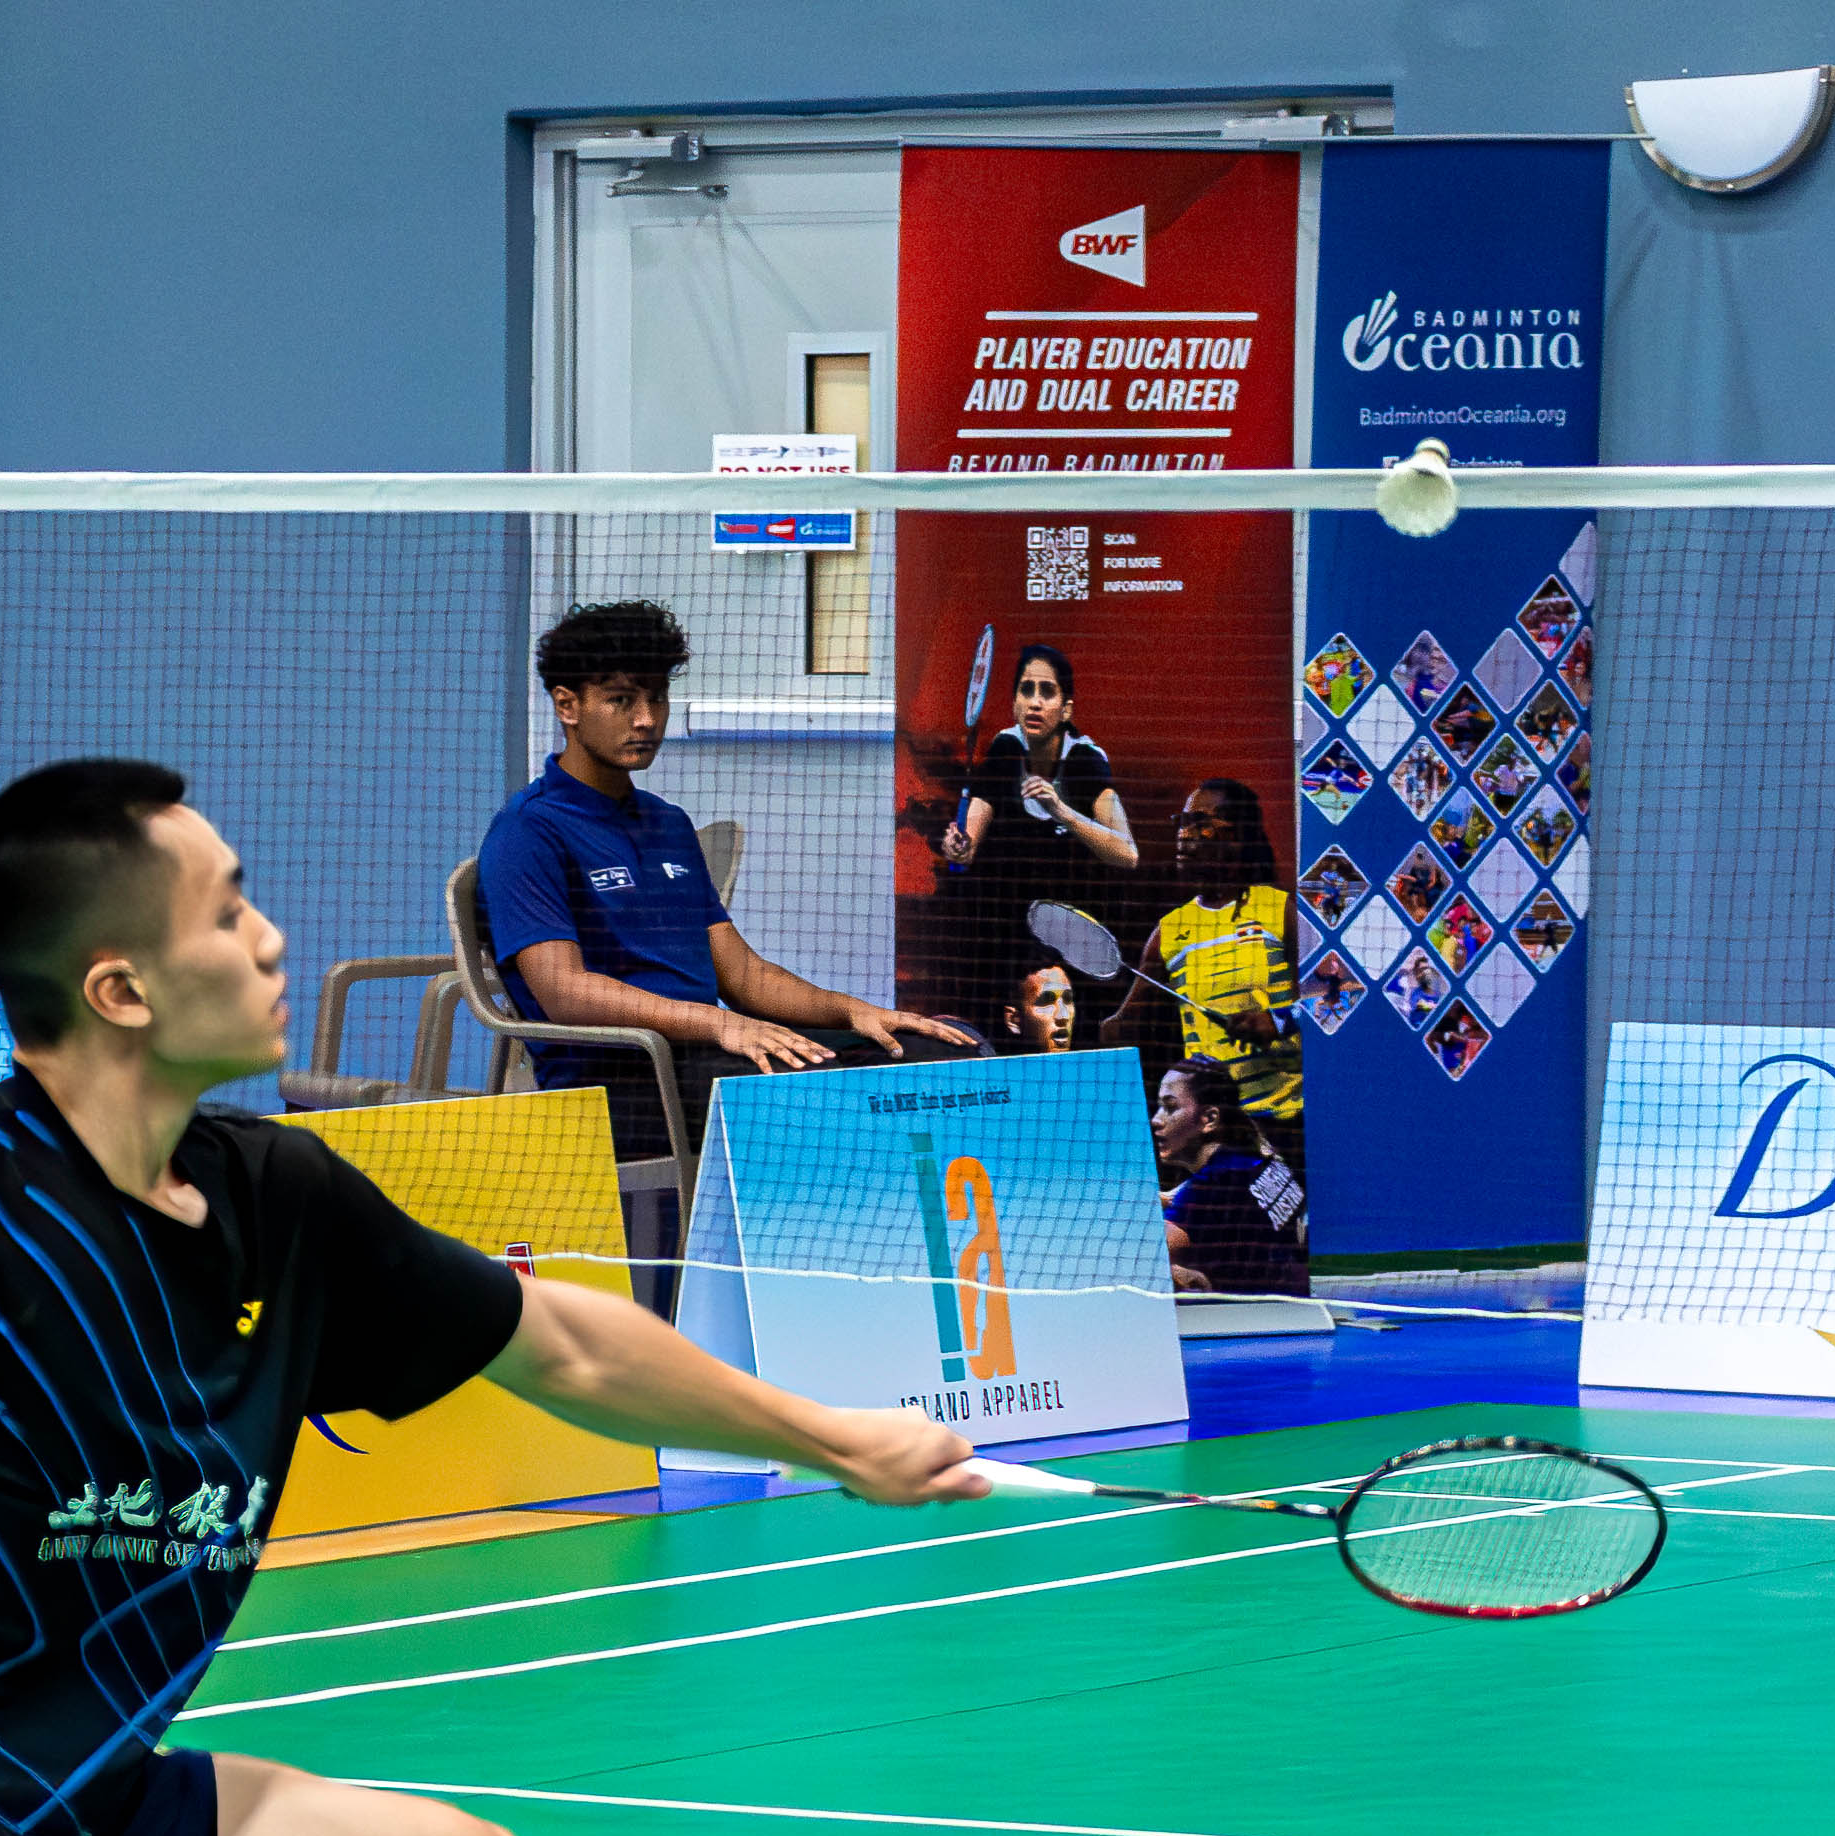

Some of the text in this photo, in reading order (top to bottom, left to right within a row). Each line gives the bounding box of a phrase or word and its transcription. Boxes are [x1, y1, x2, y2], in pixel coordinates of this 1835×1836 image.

[1071, 233, 1138, 255] BWF
[1413, 309, 1581, 328] BADMINTON
[1343, 297, 1584, 372] Oceania
[974, 337, 1252, 371] PLAYER EDUCATION
[964, 379, 1240, 412] AND DUAL CAREER
[1358, 404, 1566, 427] BadmintonOceania.org
[948, 453, 1226, 472] BEYOND BADMINTON
[1103, 533, 1137, 546] SCAN
[1103, 556, 1163, 570] FOR MORE
[1103, 580, 1184, 593] INFORMATION
[982, 1379, 1065, 1417] APPAREL
